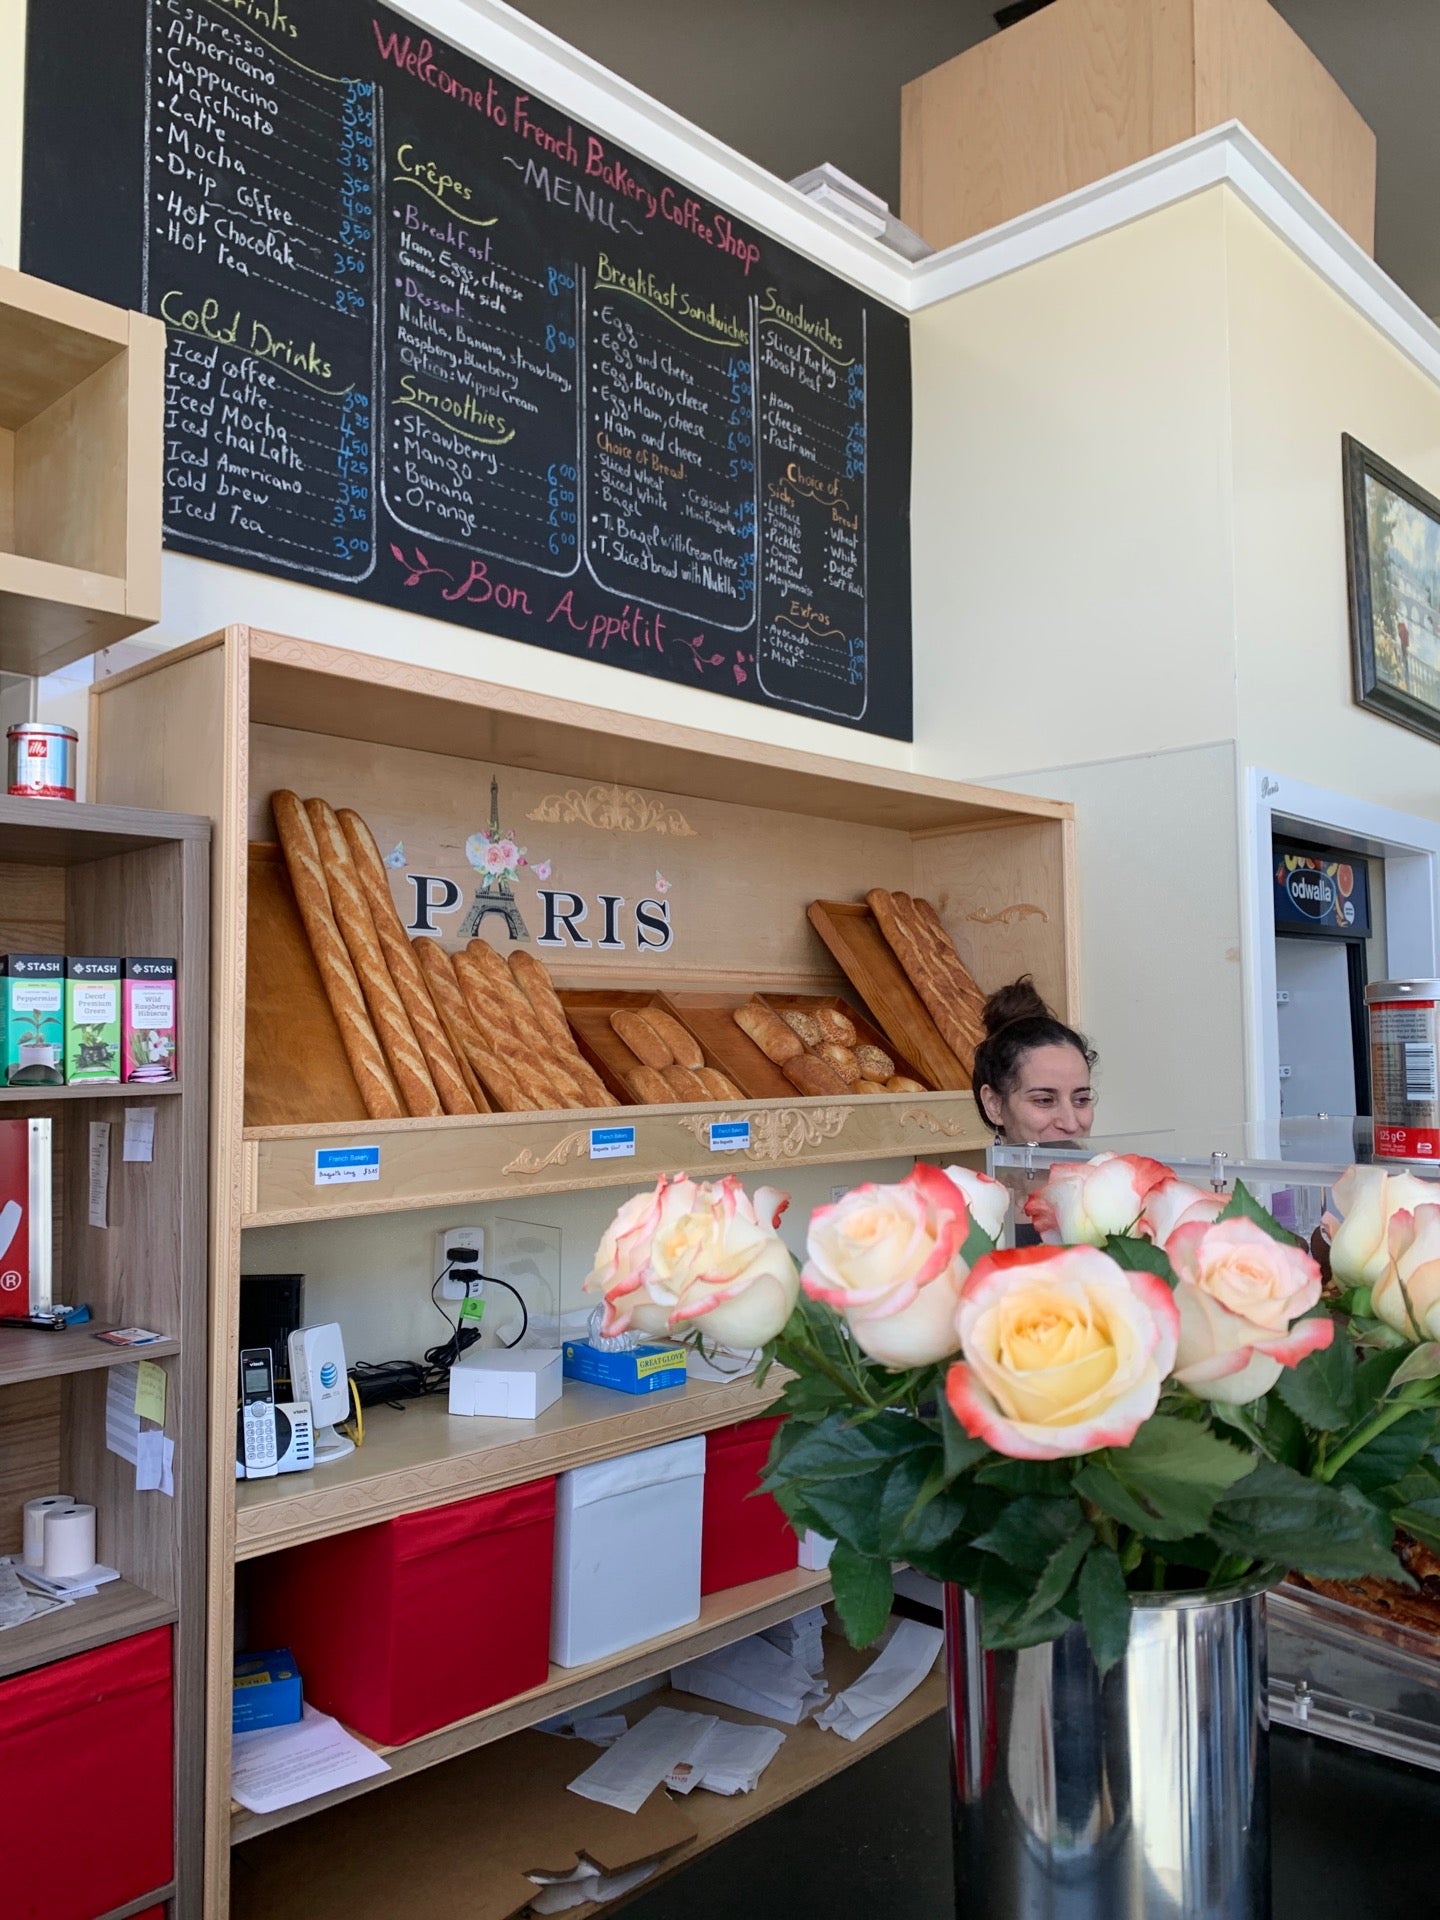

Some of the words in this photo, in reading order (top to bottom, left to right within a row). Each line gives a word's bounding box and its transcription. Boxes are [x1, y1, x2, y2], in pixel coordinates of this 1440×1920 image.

[167, 0, 264, 57] Espresso
[222, 0, 297, 37] rinks
[168, 19, 275, 86] Americano
[167, 47, 279, 115] Cappuccino
[168, 70, 274, 135] Macchiato
[169, 94, 225, 141] Latte
[168, 122, 246, 175] Mocha
[372, 19, 483, 110] Welcome
[486, 77, 508, 127] to
[514, 95, 578, 167] French
[586, 136, 657, 218] Bakery
[660, 187, 713, 245] Coffee
[714, 214, 761, 276] Shop
[168, 152, 217, 196] Drip
[237, 187, 293, 225] Coffee
[397, 144, 472, 200] Crêpes
[168, 191, 210, 225] Hot
[215, 219, 298, 270] Chocolate
[168, 219, 207, 254] Hot
[405, 204, 493, 262] Breakfast
[404, 277, 464, 317] Dessert
[439, 274, 455, 288] on
[459, 282, 475, 300] the
[479, 295, 507, 314] side
[598, 252, 677, 309] Breakfast
[678, 294, 749, 344] Sandwiches
[161, 291, 240, 344] Cold
[251, 320, 332, 378] Drinks
[601, 306, 638, 349] Egg
[760, 287, 843, 350] Sandwiches
[170, 339, 218, 369] Iced
[463, 350, 519, 389] Blueberry
[601, 333, 633, 370] Egg
[636, 350, 657, 369] and
[765, 331, 801, 362] Sliced
[804, 347, 837, 389] Turkey
[765, 349, 795, 378] Roast
[167, 364, 211, 390] Iced
[220, 378, 268, 409] Latte
[399, 375, 506, 434] Smoothies
[502, 390, 539, 414] Cream
[769, 392, 794, 413] Ham
[166, 385, 214, 416] Iced
[221, 405, 288, 444] Mocha
[604, 411, 636, 439] Ham
[641, 431, 666, 451] and
[768, 410, 802, 435] Cheese
[165, 410, 207, 437] Iced
[260, 437, 304, 471] Latte
[404, 415, 498, 475] Strawberry
[596, 431, 632, 459] Choice
[636, 450, 649, 464] of
[769, 428, 816, 461] Pastrami
[167, 441, 208, 468] Iced
[217, 453, 302, 494] Americano
[404, 436, 472, 487] Mango
[599, 453, 631, 477] Sliced
[787, 462, 823, 491] Choice
[167, 468, 206, 492] Cold
[217, 474, 269, 505] brew
[405, 461, 474, 505] Banana
[601, 469, 633, 496] Sliced
[603, 487, 642, 517] Bagel
[169, 495, 216, 521] Iced
[230, 504, 265, 534] Tea
[406, 487, 477, 536] Orange
[768, 483, 795, 508] Sides
[832, 507, 858, 530] Bread
[600, 513, 615, 531] T.
[617, 517, 660, 560] Bagel
[661, 534, 685, 552] with
[686, 538, 712, 562] Cream
[770, 528, 801, 554] Pickles
[770, 545, 798, 565] Onion
[599, 535, 611, 556] T.
[612, 541, 650, 571] Sliced
[651, 554, 678, 579] bread
[681, 561, 701, 584] with
[829, 575, 846, 591] Soft
[442, 560, 533, 615] Bon
[546, 590, 667, 653] Appétit
[790, 600, 830, 626] Extras
[769, 624, 810, 646] Avocado
[770, 636, 804, 659] Cheese
[771, 649, 798, 668] Meat
[29, 741, 47, 757] illy
[1291, 877, 1331, 902] odwalla
[27, 962, 60, 971] STASH
[85, 964, 117, 973] STASH
[143, 965, 173, 973] STASH
